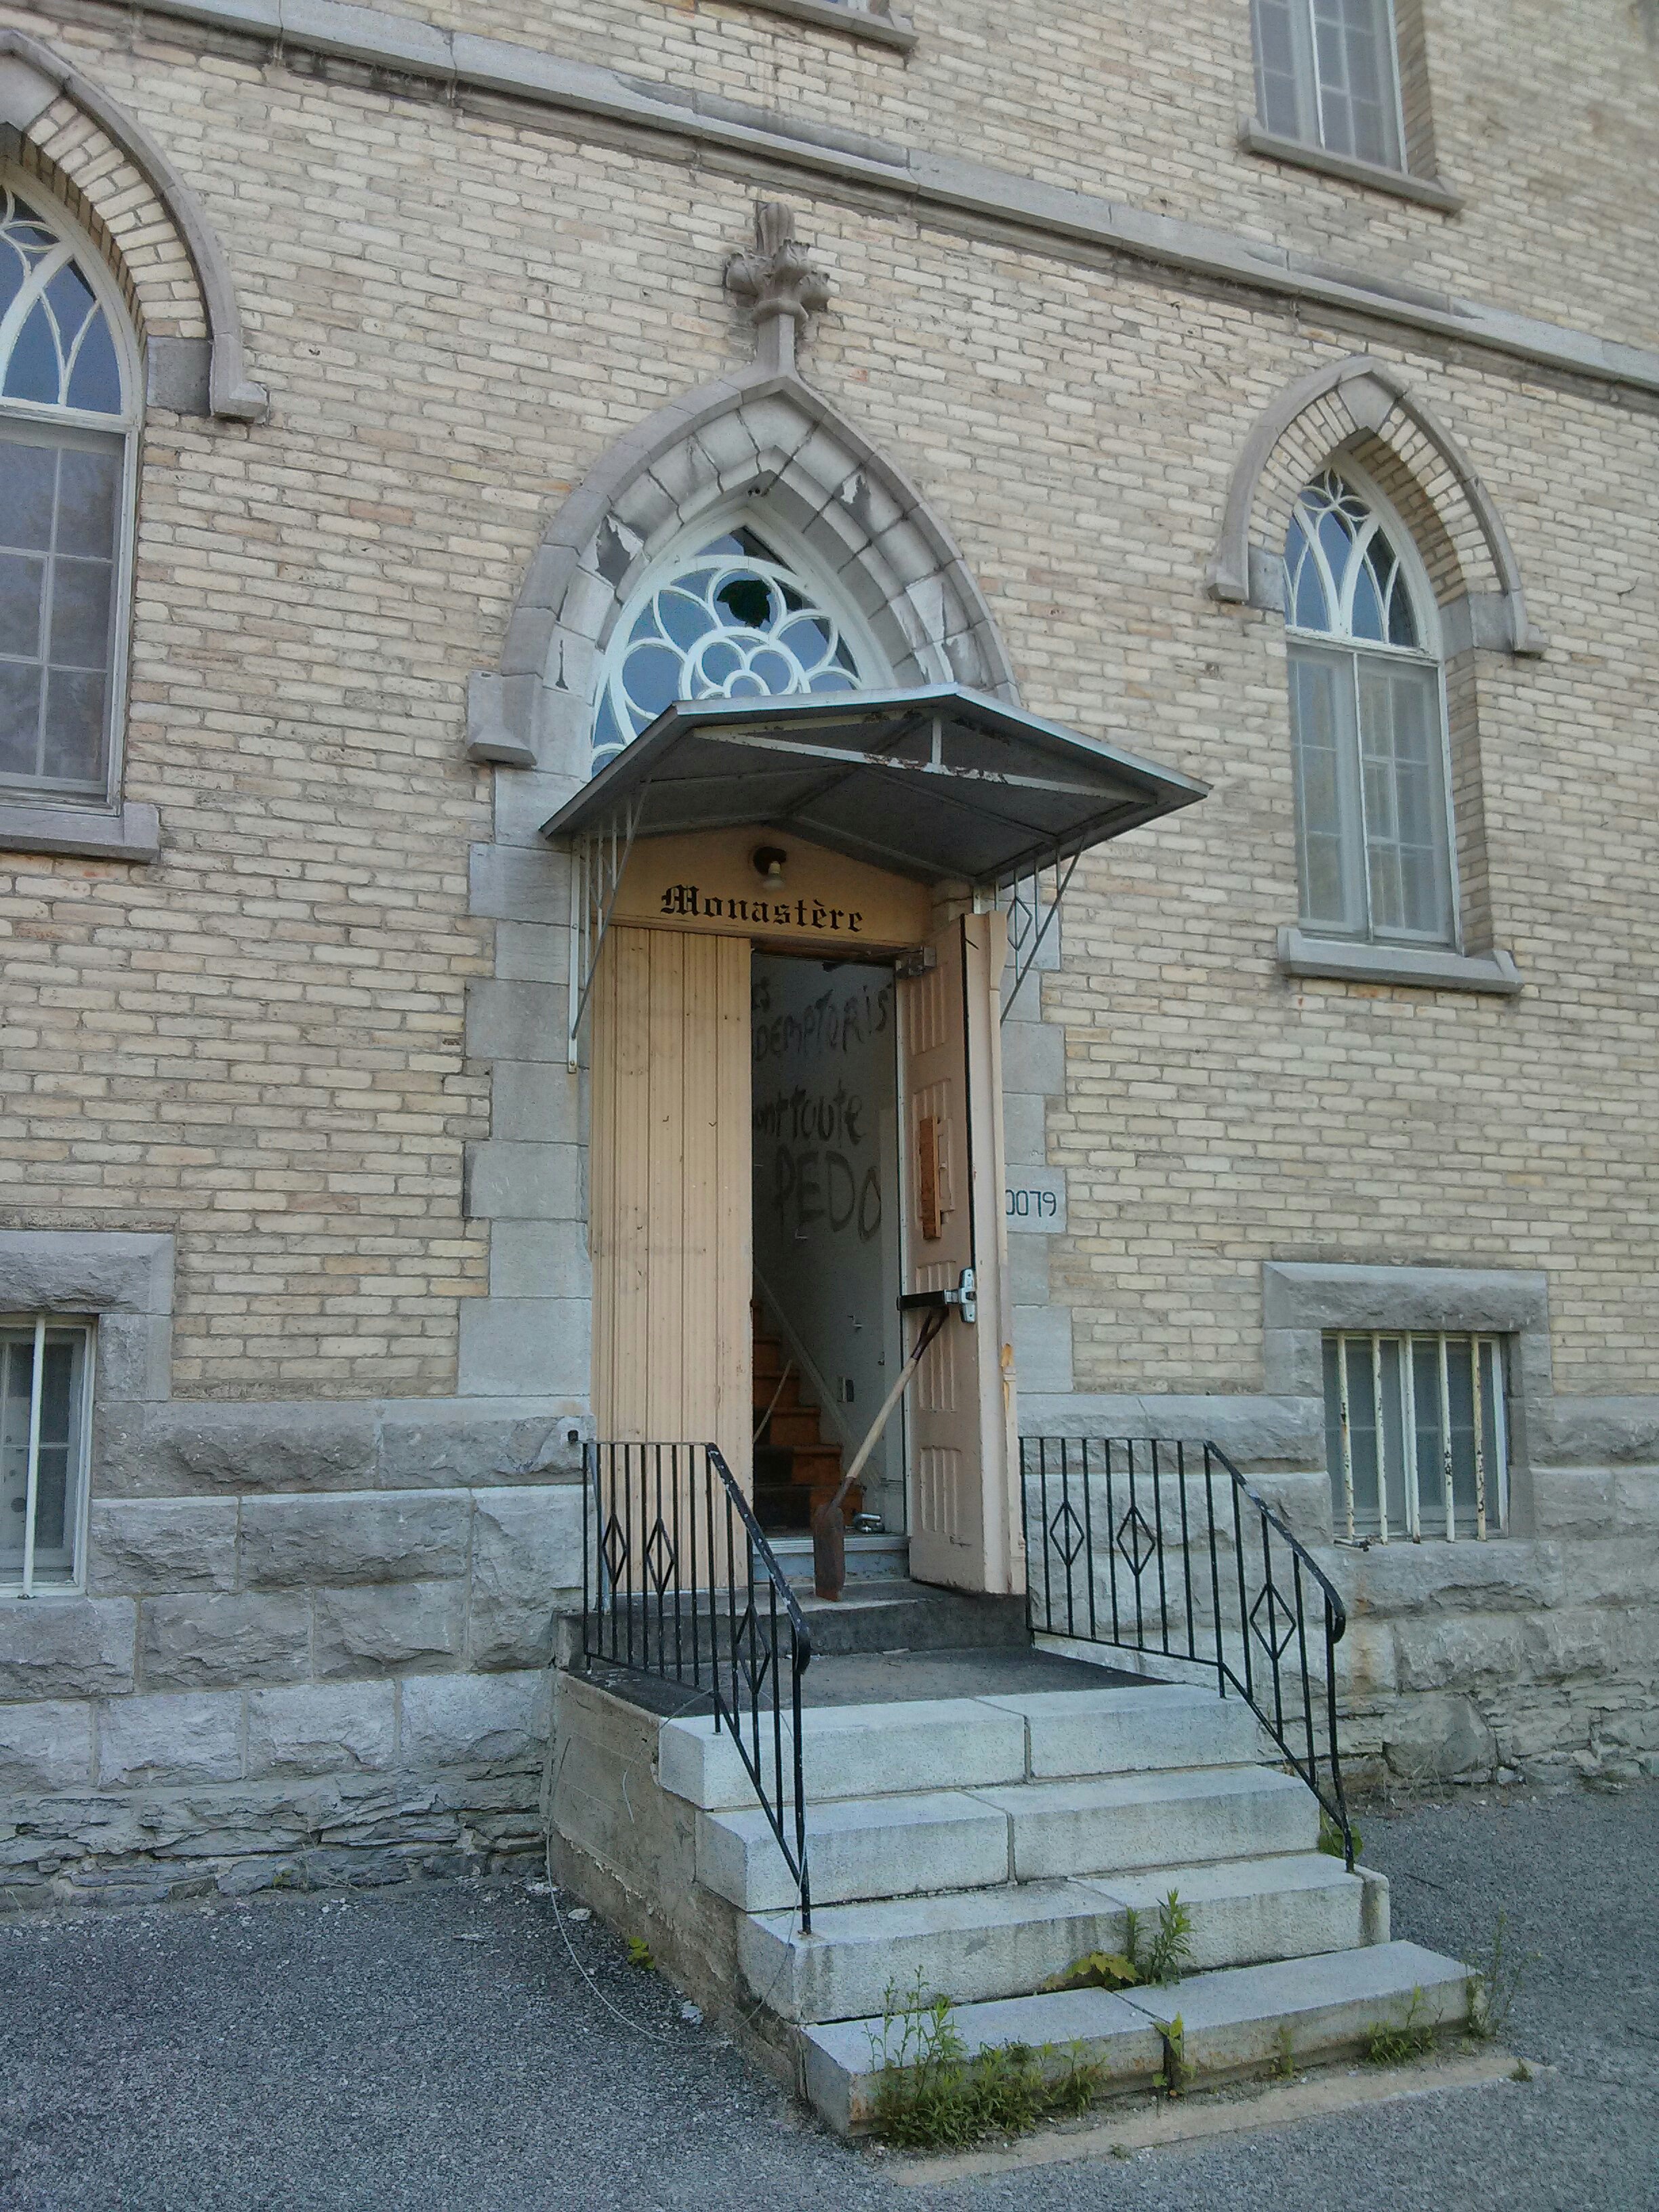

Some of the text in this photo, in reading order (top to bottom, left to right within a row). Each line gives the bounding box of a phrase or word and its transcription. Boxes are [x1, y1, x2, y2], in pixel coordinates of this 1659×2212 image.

[660, 884, 863, 933] Monastère
[772, 1145, 882, 1244] PEDO
[1005, 1189, 1057, 1218] 0079
